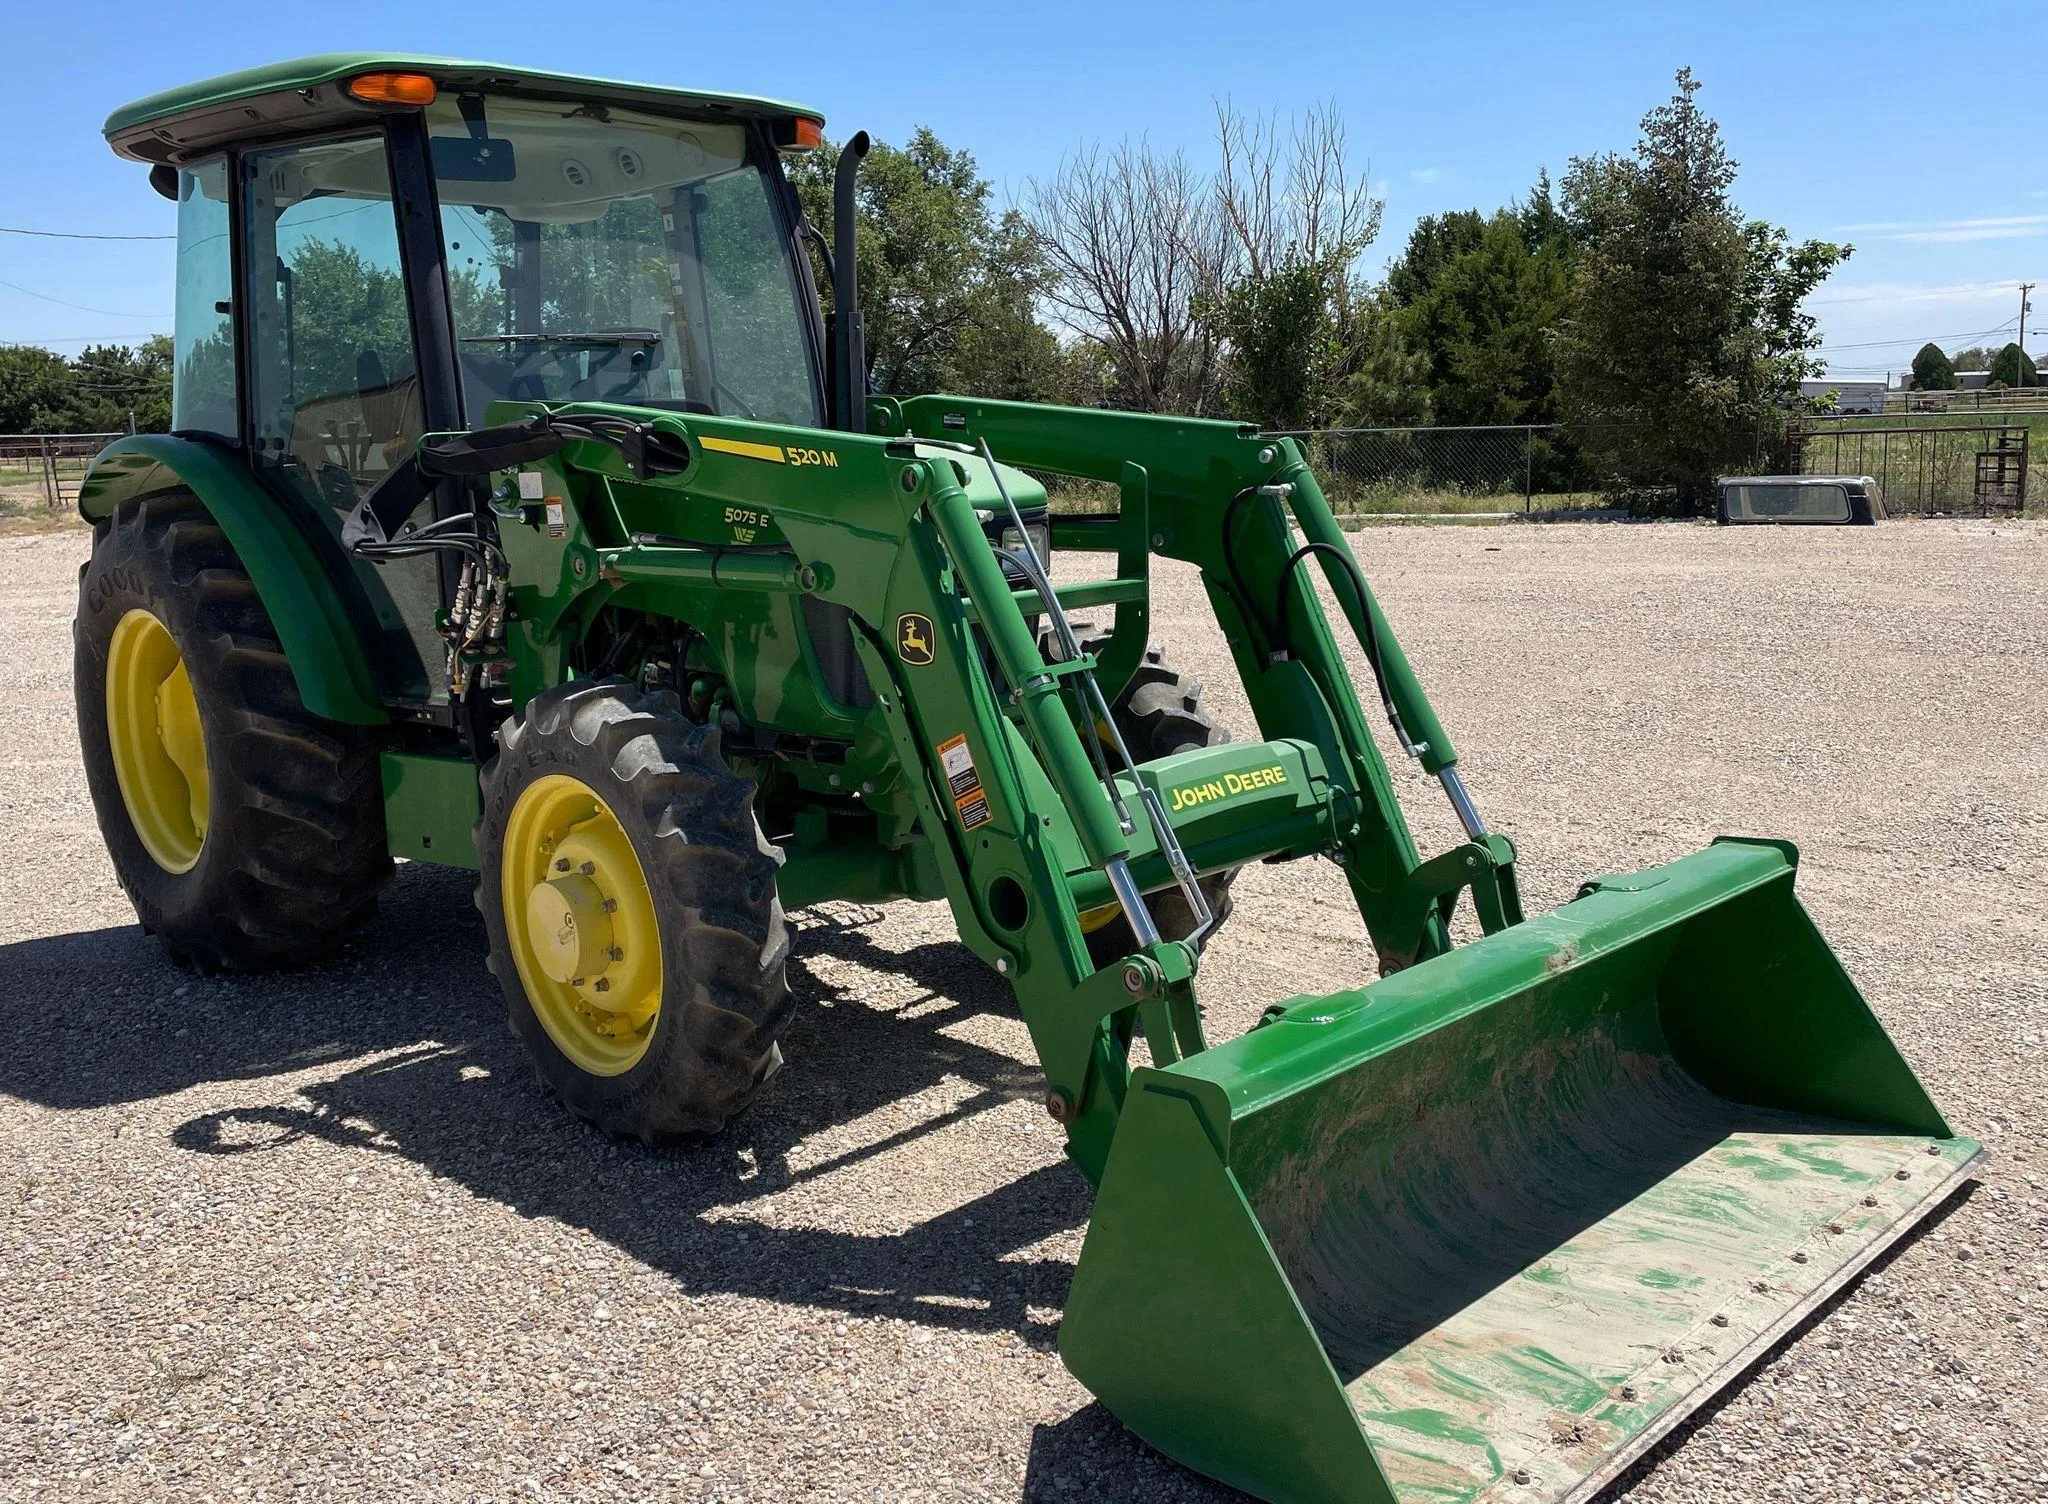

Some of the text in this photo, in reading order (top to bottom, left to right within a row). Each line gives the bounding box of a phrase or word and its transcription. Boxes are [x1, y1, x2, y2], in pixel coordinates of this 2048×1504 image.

[786, 447, 839, 468] 520 M
[724, 507, 770, 528] 5075 E
[1172, 765, 1288, 811] JOHN DEERE
